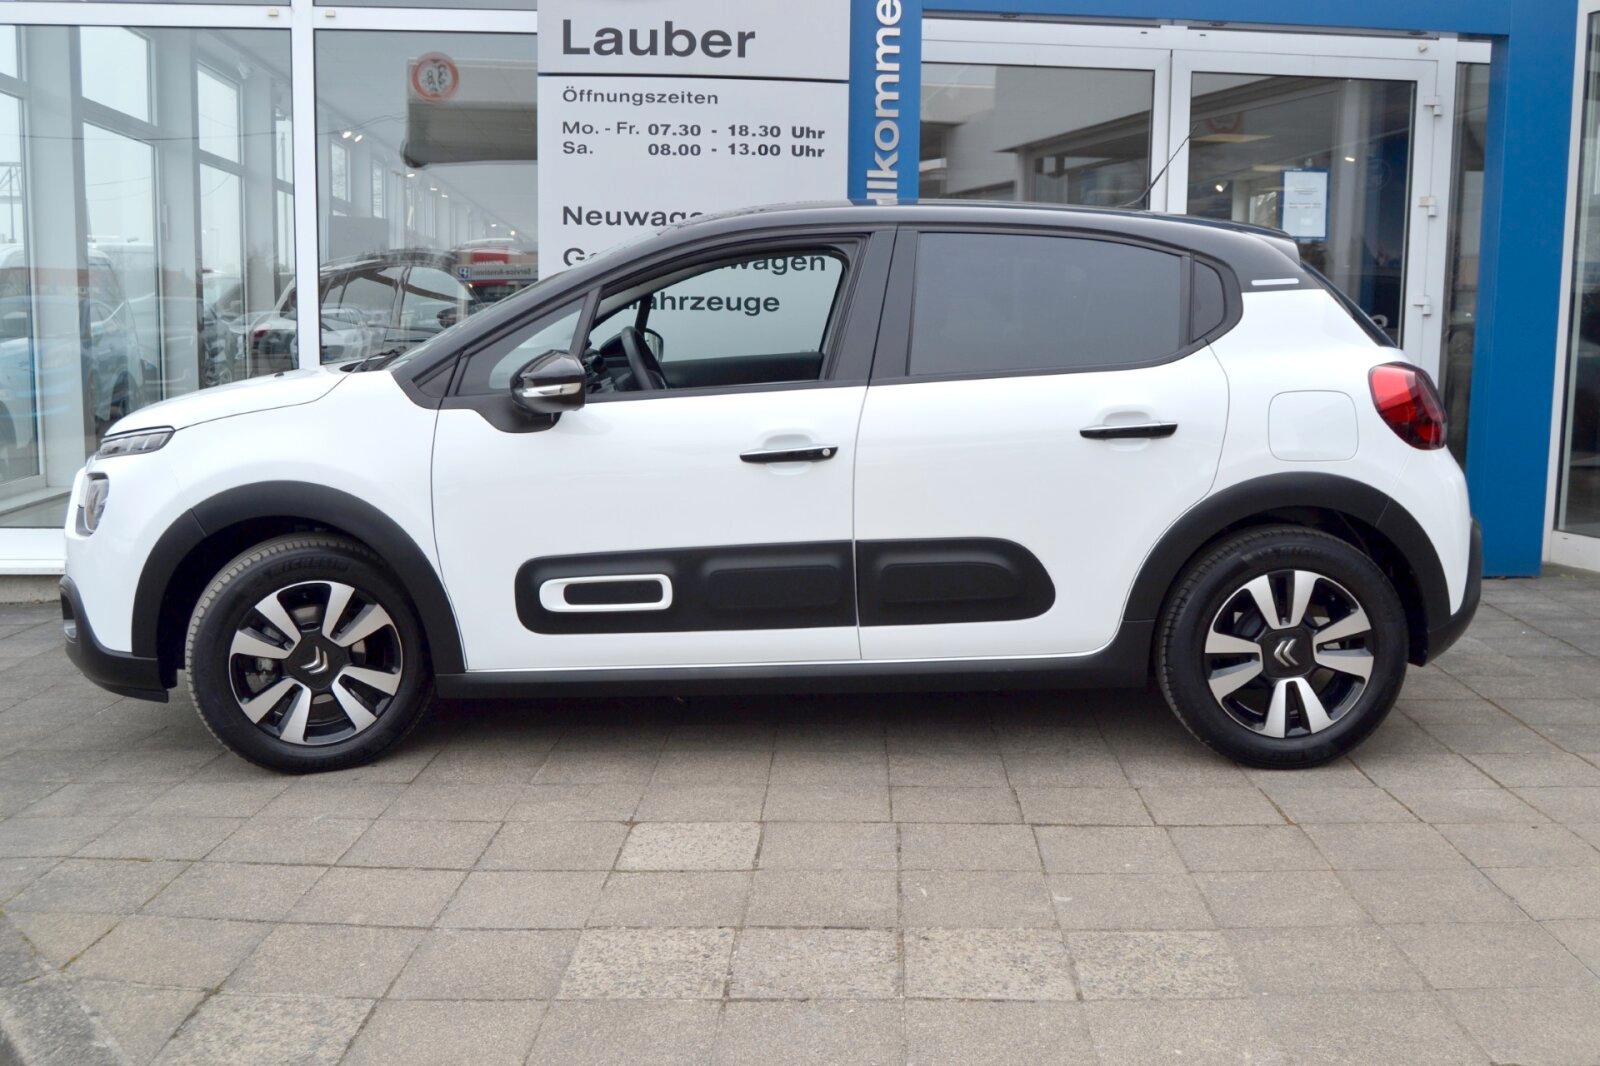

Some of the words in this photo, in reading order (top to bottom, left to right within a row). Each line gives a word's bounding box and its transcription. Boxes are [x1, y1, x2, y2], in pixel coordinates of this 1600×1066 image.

[562, 18, 758, 59] Lauber
[562, 86, 718, 106] Öffnungszeiten
[562, 121, 600, 136] Mo.
[616, 121, 640, 136] Fr.
[647, 123, 702, 137] 07.30
[728, 124, 782, 138] 18.30
[791, 125, 827, 139] Uhr
[562, 140, 594, 155] Sa.
[647, 143, 702, 157] 08.00
[728, 143, 782, 157] 13.00
[791, 144, 826, 158] Uhr
